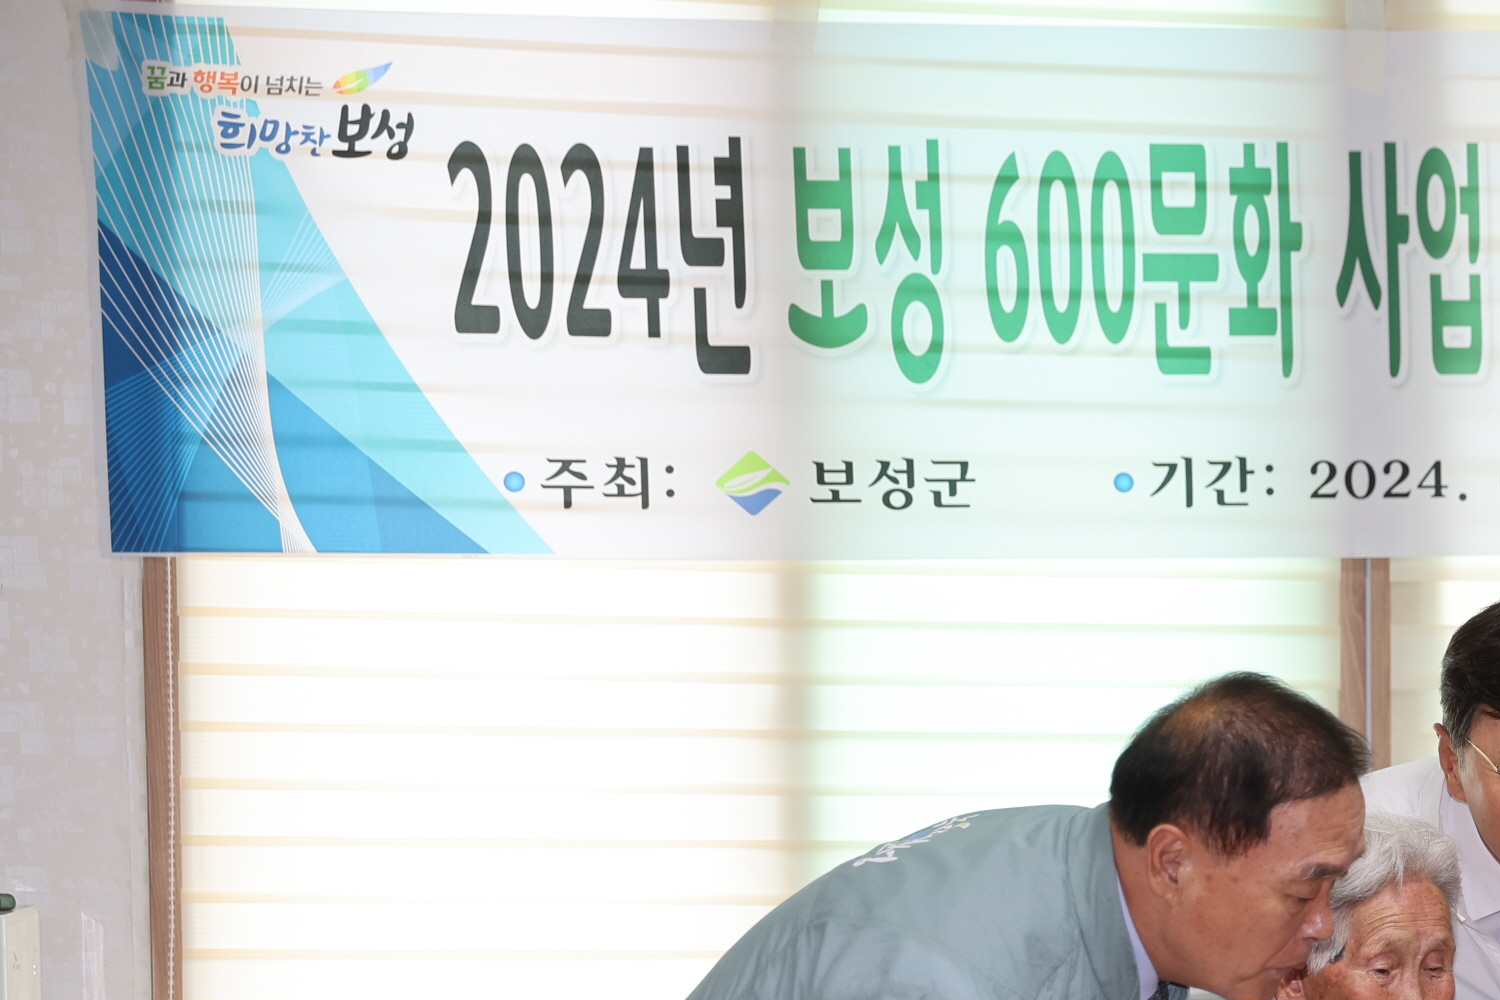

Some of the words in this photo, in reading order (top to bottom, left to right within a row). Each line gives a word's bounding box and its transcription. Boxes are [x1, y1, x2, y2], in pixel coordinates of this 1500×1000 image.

[146, 64, 188, 91] 꿈과
[193, 68, 259, 96] 행복이
[265, 75, 324, 97] 넘치는
[216, 110, 331, 157] 희망찬
[331, 102, 415, 161] 보성
[447, 136, 753, 376] 2024년
[787, 138, 946, 385] 보성
[984, 140, 1304, 379] 600문화
[1335, 141, 1484, 378] 사업
[540, 456, 676, 511] 주최:
[808, 457, 977, 512] 보성군
[1150, 456, 1276, 508] 기간:
[1309, 459, 1468, 501] 2024.
